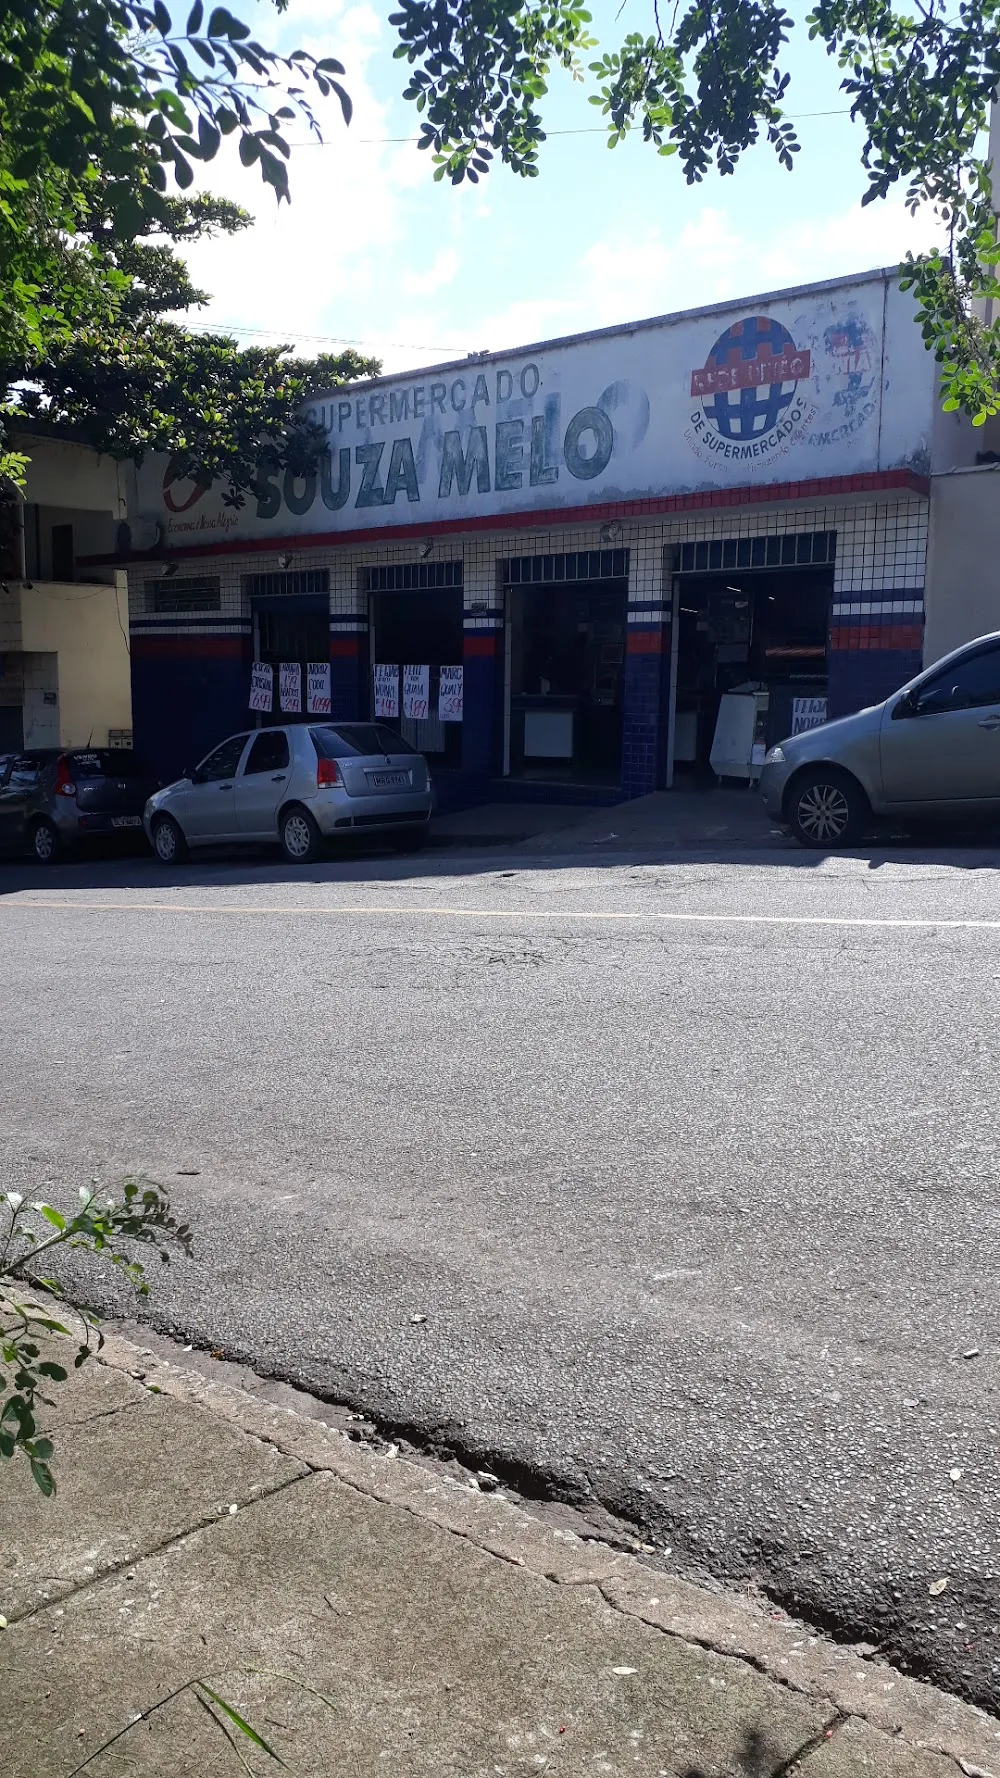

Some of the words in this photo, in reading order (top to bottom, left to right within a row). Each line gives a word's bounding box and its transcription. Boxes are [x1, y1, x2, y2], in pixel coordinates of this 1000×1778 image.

[305, 362, 541, 434] SUPERMERCADO
[690, 411, 706, 434] DE
[702, 397, 807, 459] SUPERMERCADOS
[256, 439, 421, 519] SOUZA
[438, 405, 615, 499] MELO
